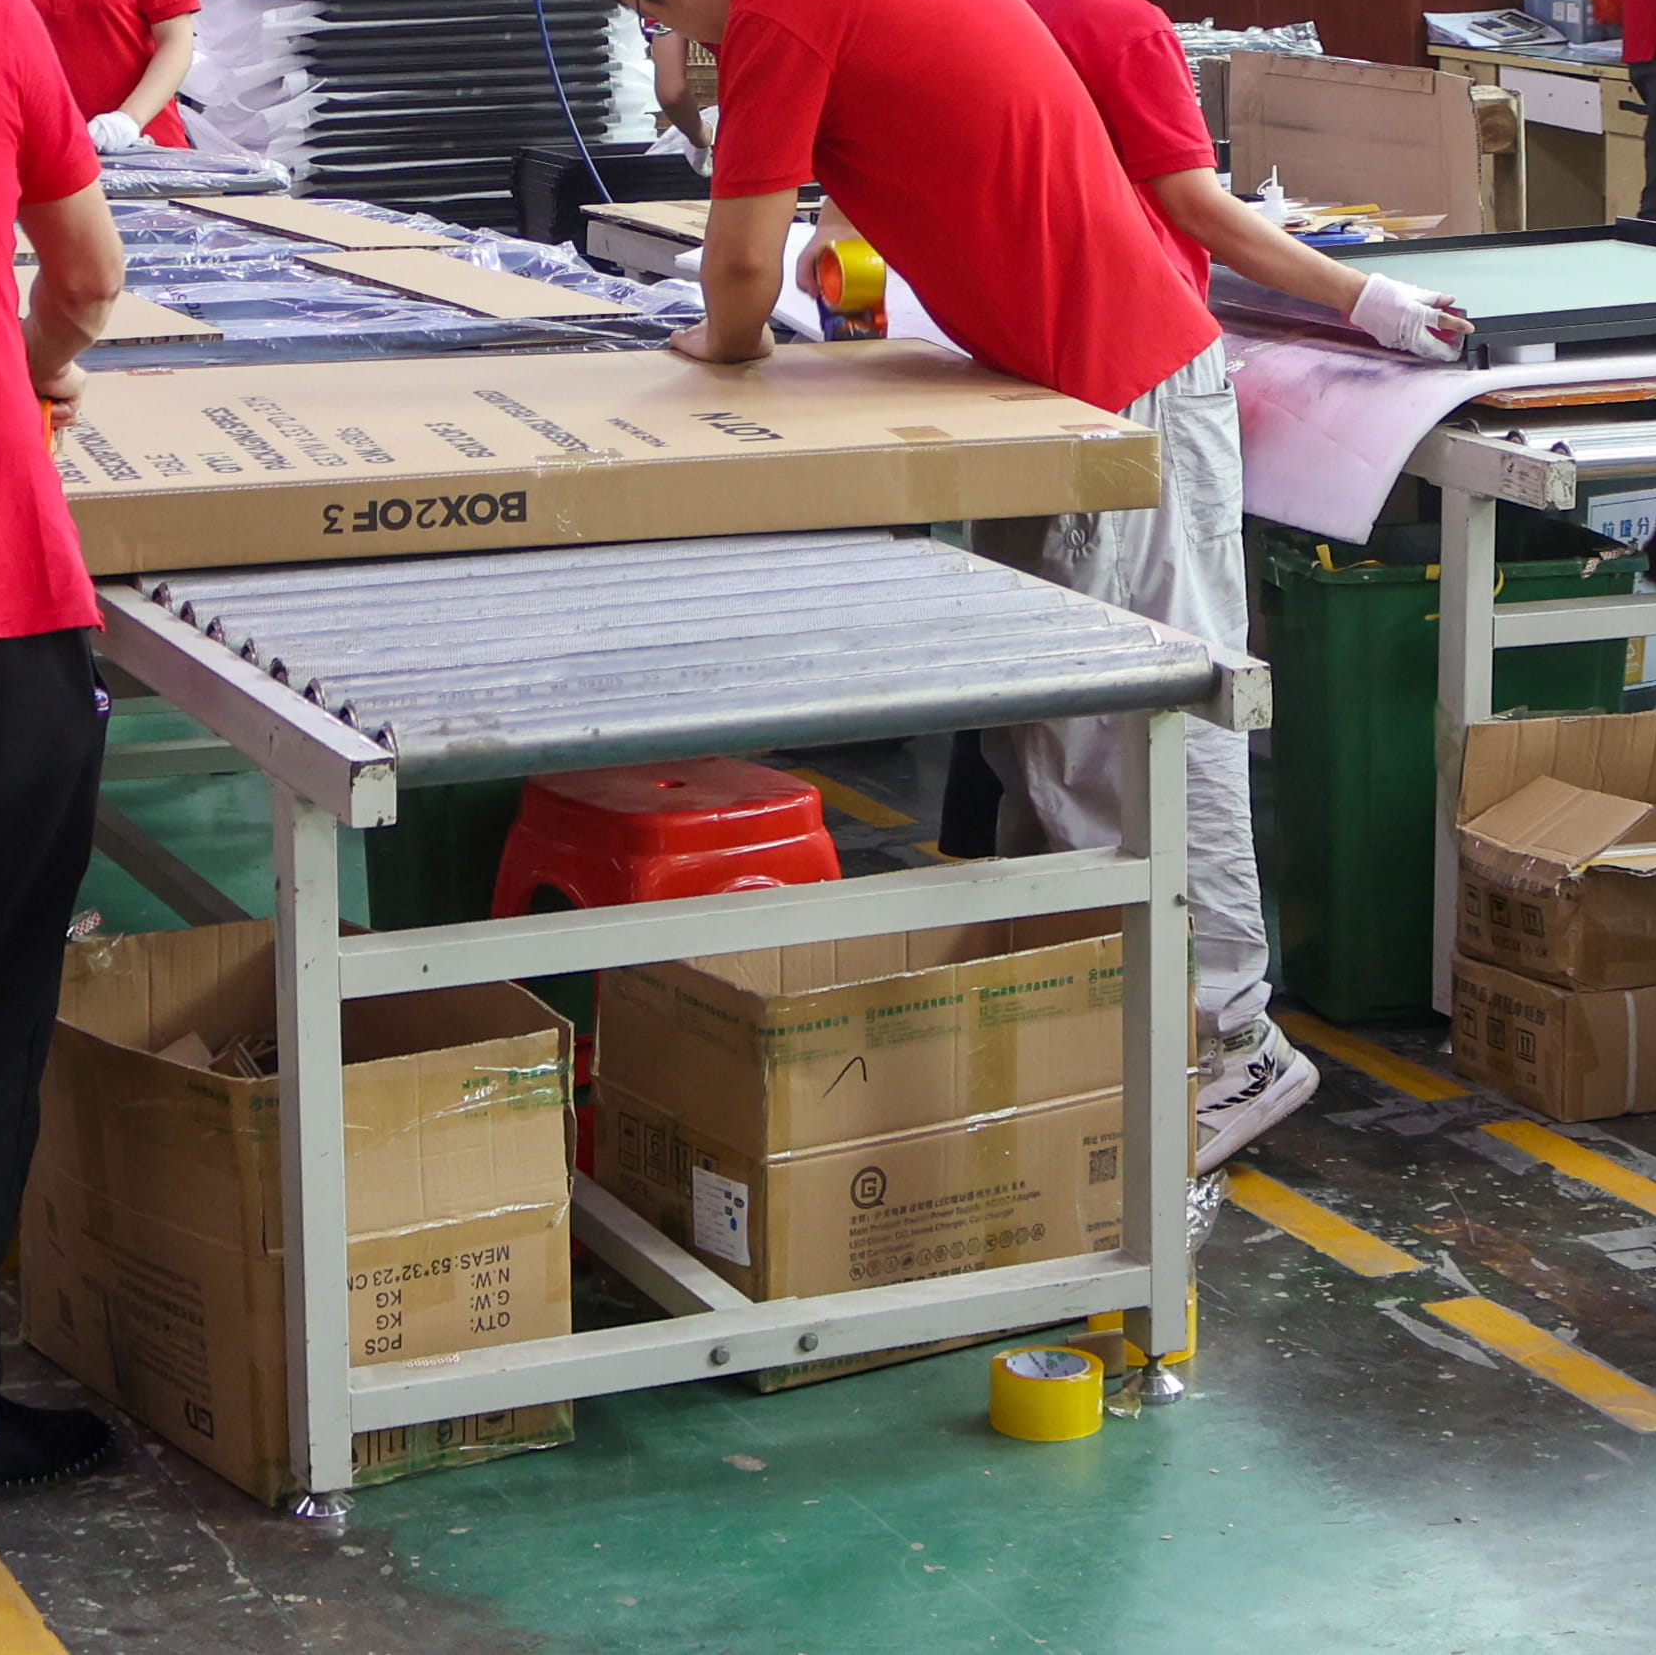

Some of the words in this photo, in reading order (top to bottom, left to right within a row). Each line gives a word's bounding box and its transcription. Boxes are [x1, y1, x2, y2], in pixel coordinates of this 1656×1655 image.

[710, 422, 784, 442] LOT
[144, 453, 193, 477] TABLE
[323, 504, 345, 535] 3
[455, 1244, 510, 1270] MEAS:
[471, 1267, 510, 1289] N.W:
[376, 1288, 402, 1309] KG
[470, 1290, 510, 1312] G.W:
[376, 1311, 402, 1330] KG
[470, 1311, 511, 1334] QTY:
[364, 1333, 403, 1355] PCS
